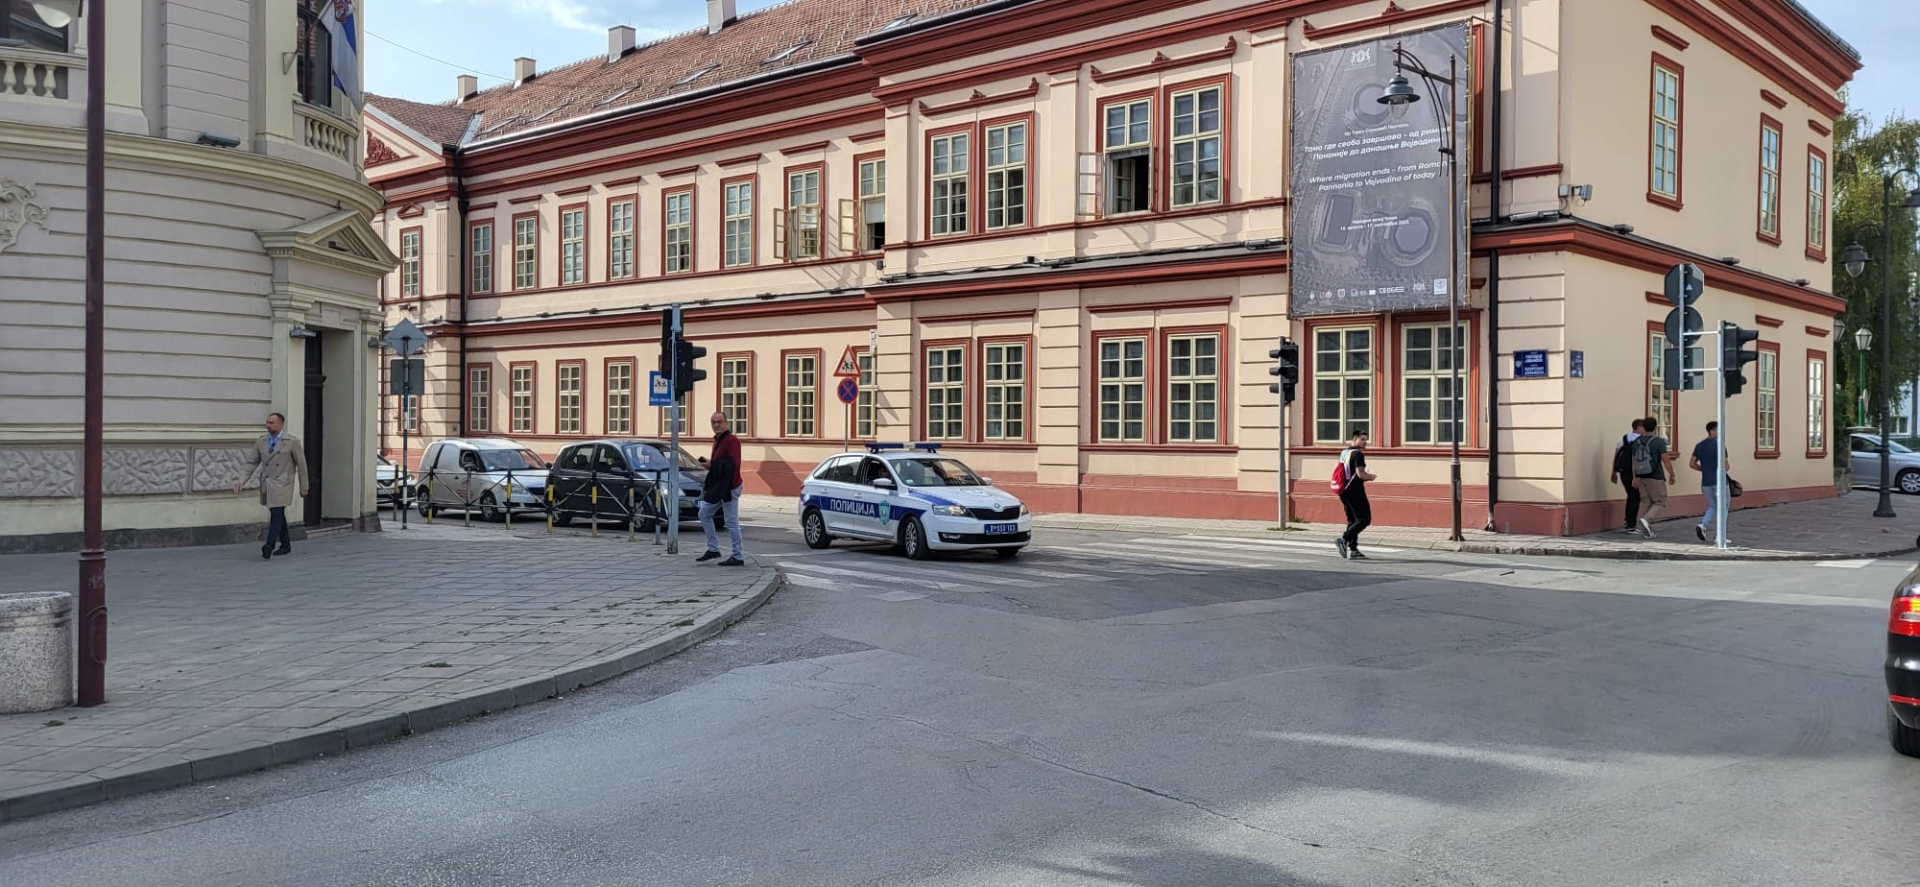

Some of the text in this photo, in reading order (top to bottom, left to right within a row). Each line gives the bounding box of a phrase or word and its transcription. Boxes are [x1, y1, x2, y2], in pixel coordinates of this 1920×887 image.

[1338, 139, 1360, 147] сеоба
[1362, 131, 1401, 145] завршава
[1313, 149, 1348, 160] Паноније
[1360, 142, 1399, 154] данашње
[1309, 175, 1333, 184] Where
[1334, 170, 1370, 180] migration
[1372, 166, 1390, 176] ends
[1397, 164, 1416, 172] from
[1419, 160, 1447, 169] Roman
[1319, 180, 1354, 191] Pannonia
[1365, 174, 1402, 186] Vojvodina
[1403, 172, 1412, 181] of
[1413, 171, 1436, 180] today
[830, 499, 876, 516] ПОЛИЦИЈА
